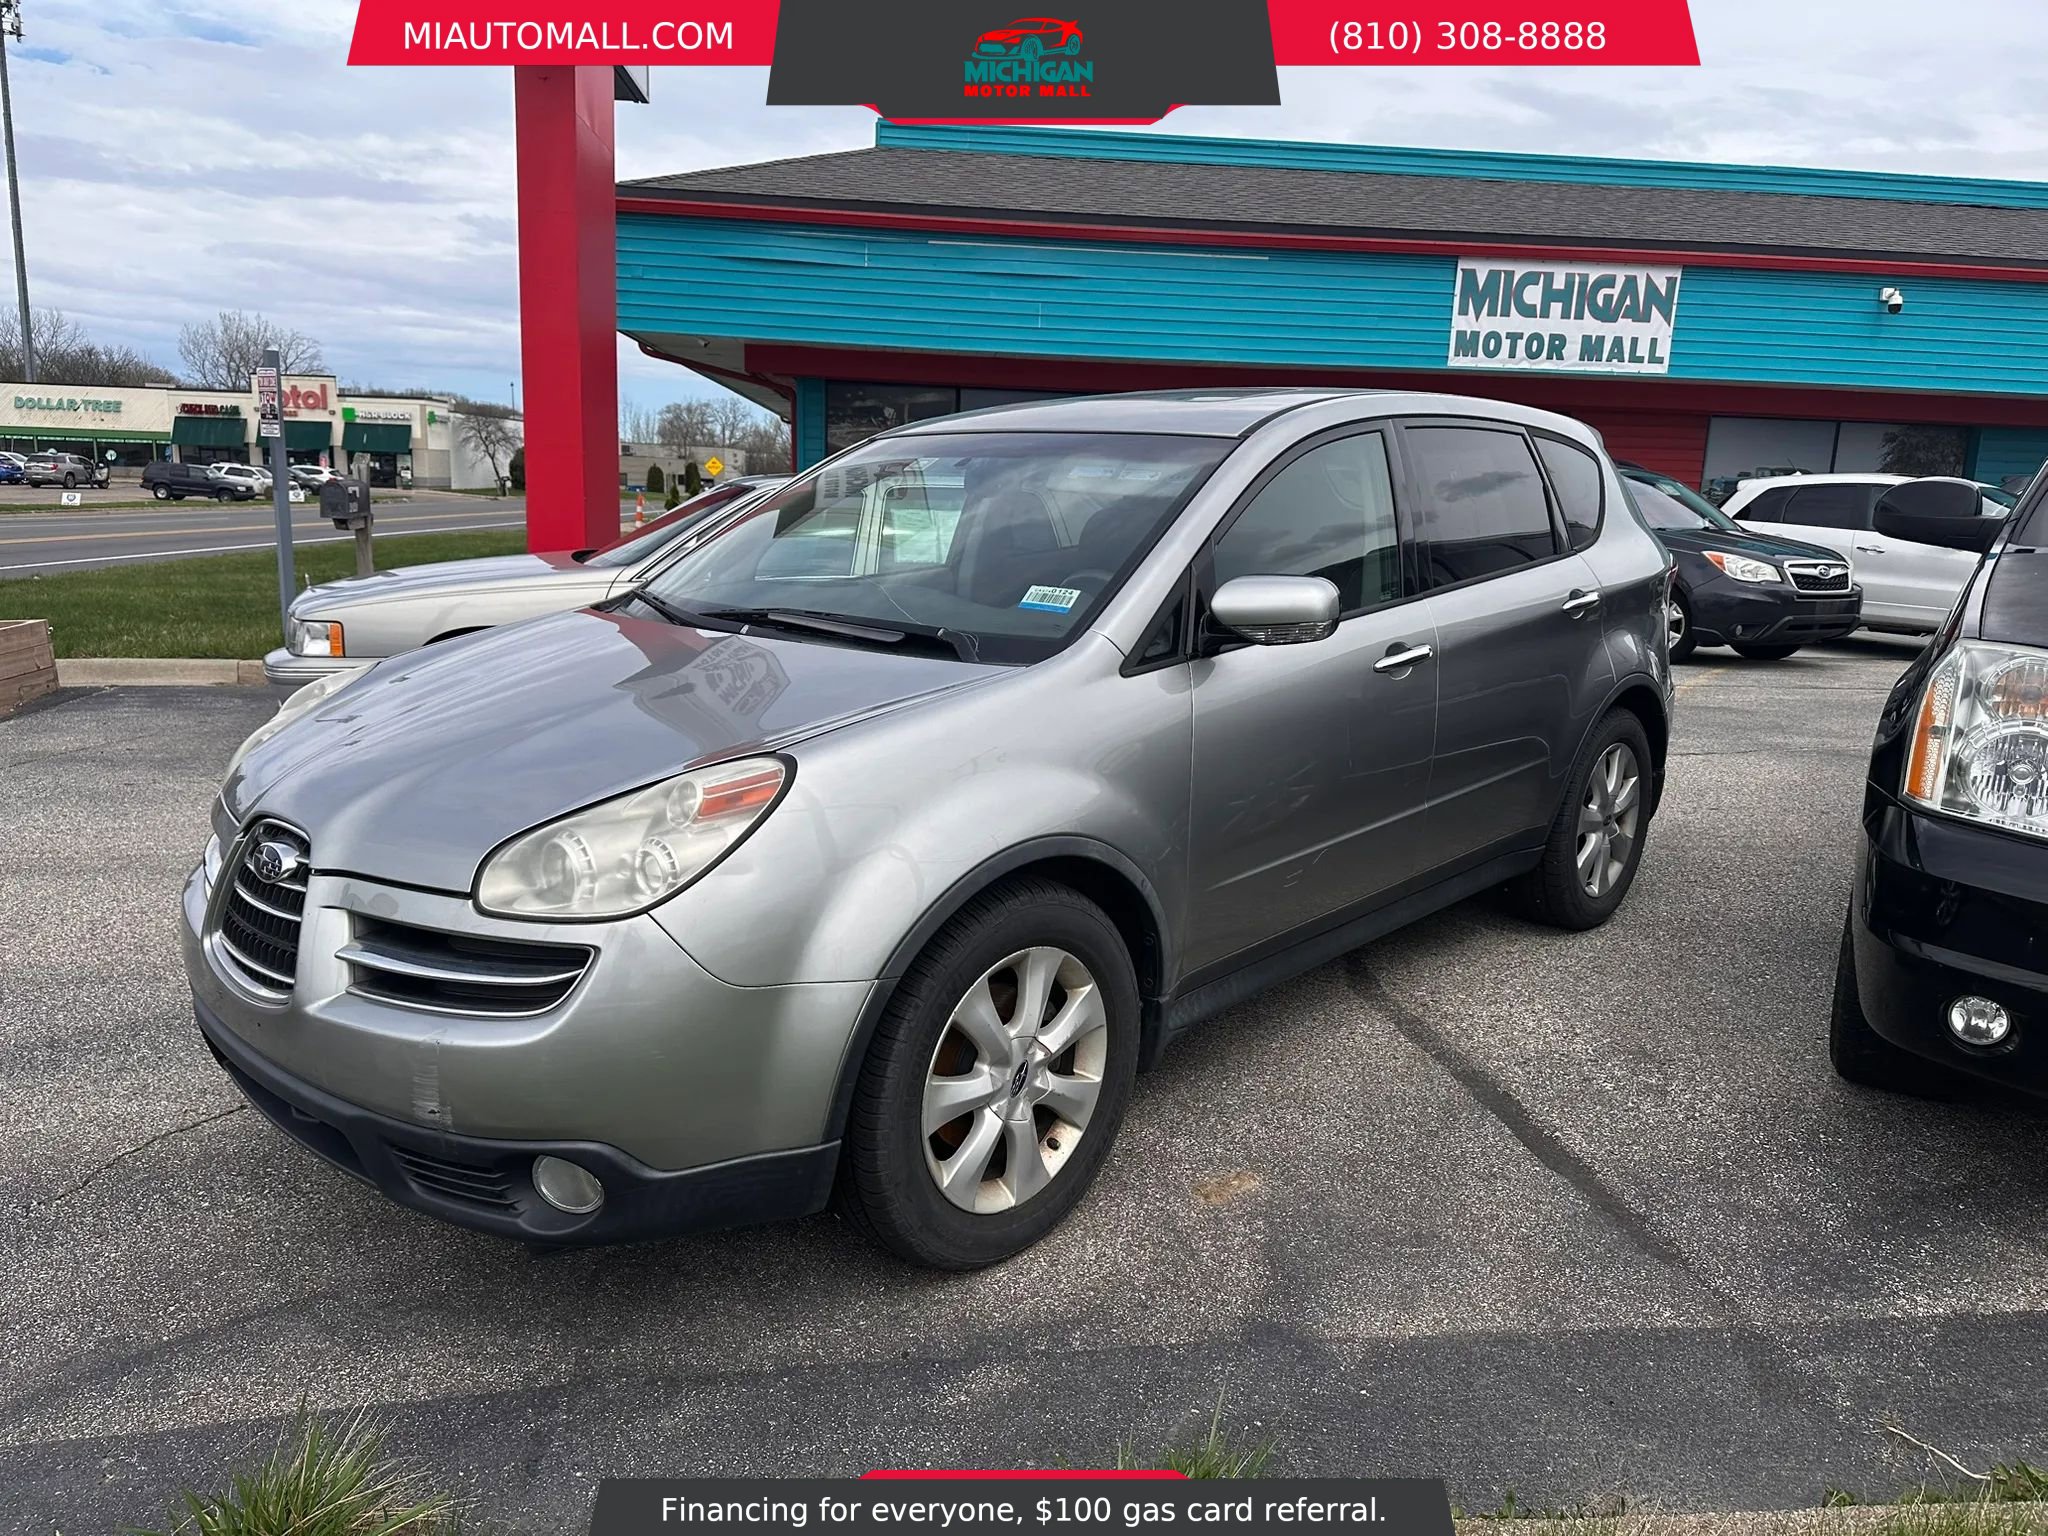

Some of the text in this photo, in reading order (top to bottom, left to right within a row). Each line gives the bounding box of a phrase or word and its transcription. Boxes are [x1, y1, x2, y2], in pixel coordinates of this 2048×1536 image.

[1457, 267, 1678, 328] MICHIGAN
[1453, 329, 1665, 365] MOTOR MALL
[14, 396, 123, 413] DOLLAR TREE
[380, 410, 412, 421] BLOCK
